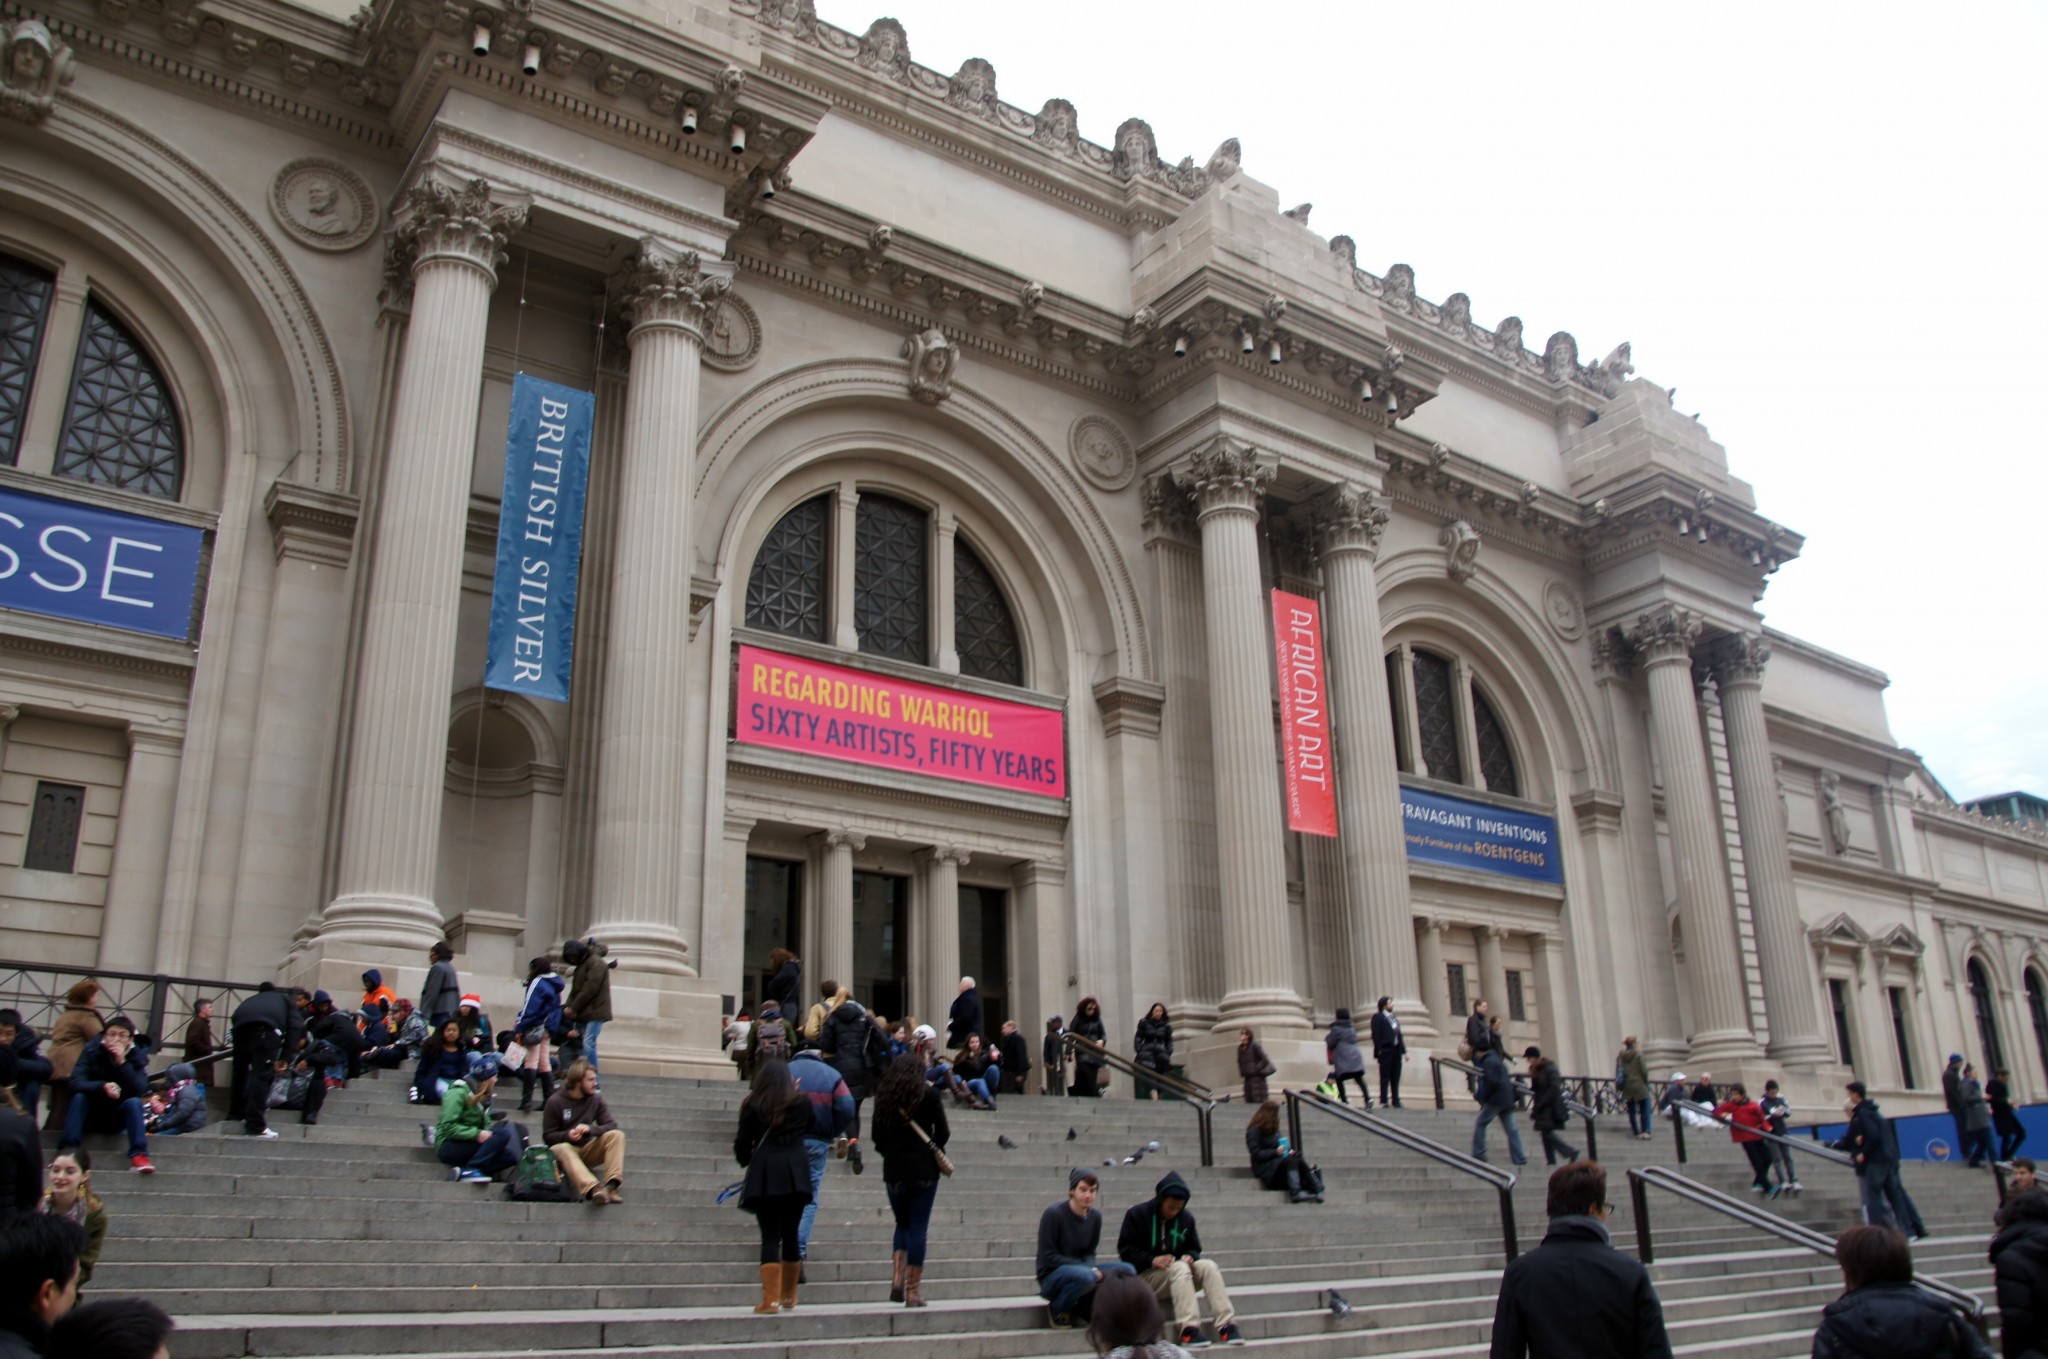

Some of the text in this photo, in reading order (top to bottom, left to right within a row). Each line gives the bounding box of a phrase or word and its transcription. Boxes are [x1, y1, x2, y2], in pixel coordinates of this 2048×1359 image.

[513, 395, 569, 684] BRITISH SILVER
[753, 663, 994, 739] REGARDING WARHOL
[1290, 608, 1326, 792] AFRICAN ART
[751, 703, 1057, 785] SIXTY ARTISTS, FIFTY YEARS
[1400, 802, 1548, 845] TRAVAGANT INVENTIONS
[1475, 841, 1546, 868] ROENTGENS
